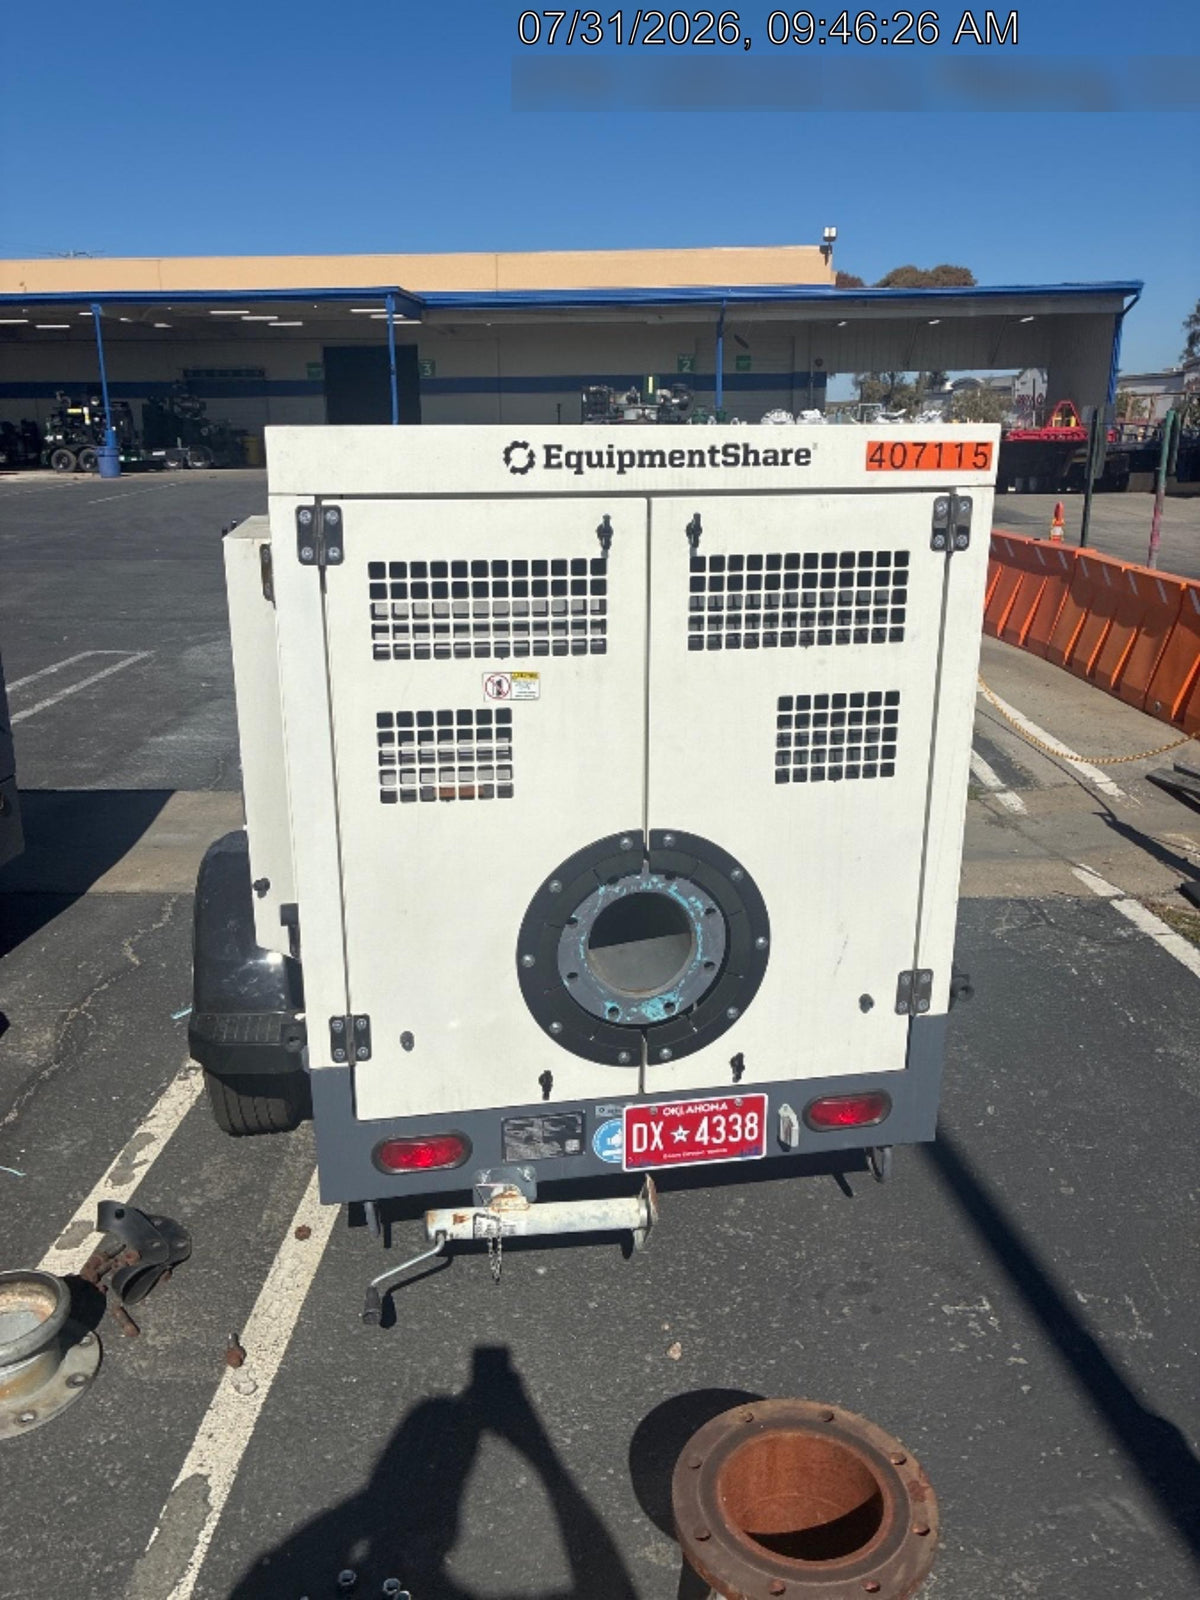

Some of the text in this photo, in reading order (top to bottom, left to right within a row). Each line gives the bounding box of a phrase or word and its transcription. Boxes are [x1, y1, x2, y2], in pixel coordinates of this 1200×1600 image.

[543, 443, 812, 475] EquipmentShare
[868, 441, 990, 471] 407115
[662, 1102, 728, 1116] OKLAHOMA
[632, 1121, 664, 1154] DX
[694, 1112, 759, 1145] 4338
